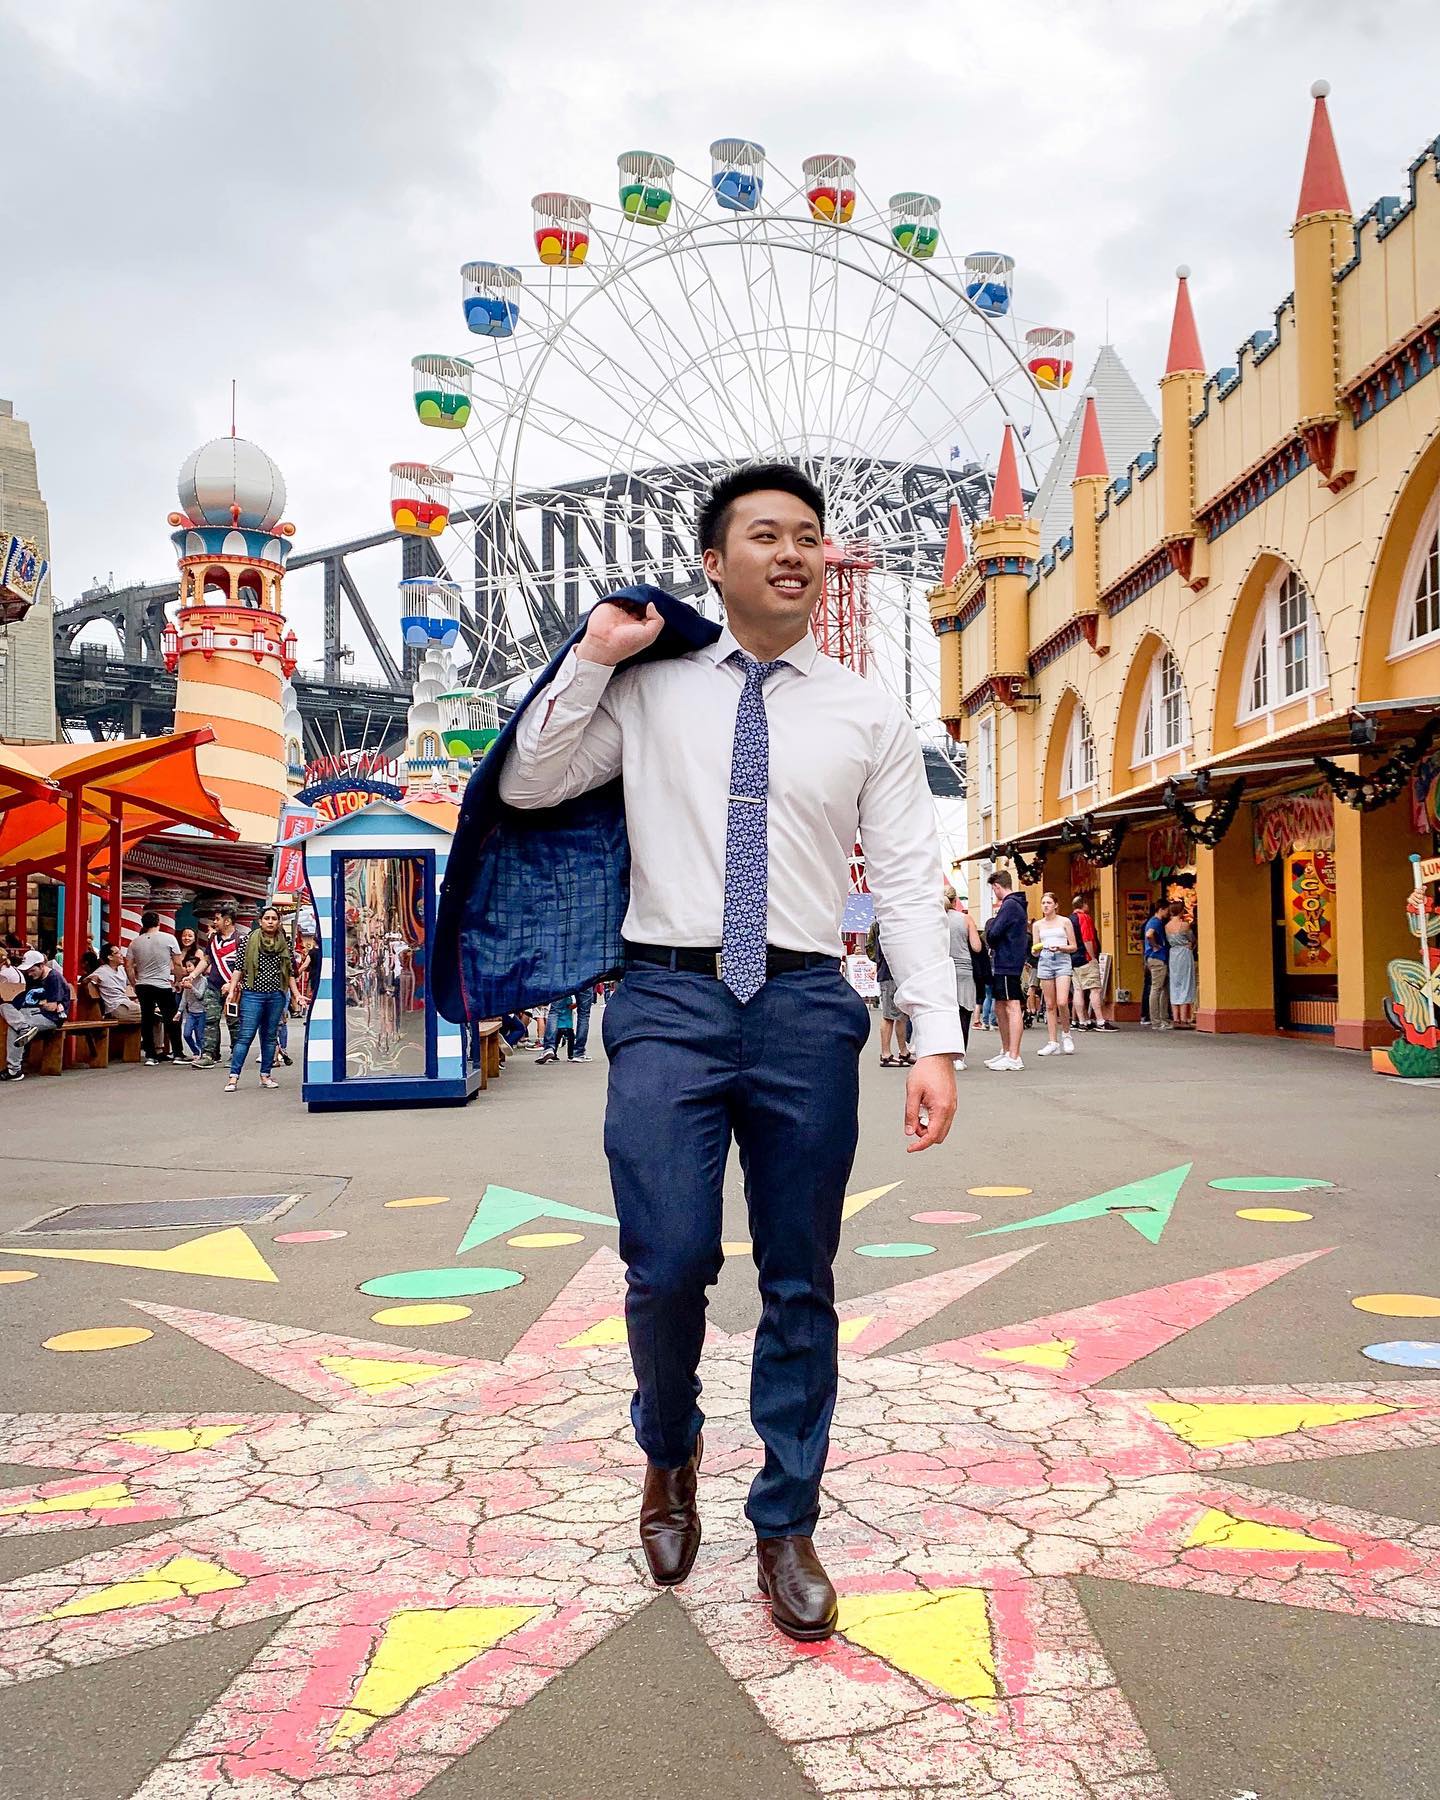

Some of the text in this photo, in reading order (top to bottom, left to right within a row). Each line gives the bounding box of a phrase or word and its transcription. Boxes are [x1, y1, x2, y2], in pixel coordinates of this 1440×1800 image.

[312, 797, 337, 820] ST
[337, 791, 369, 815] FOR
[1422, 862, 1440, 877] LUN
